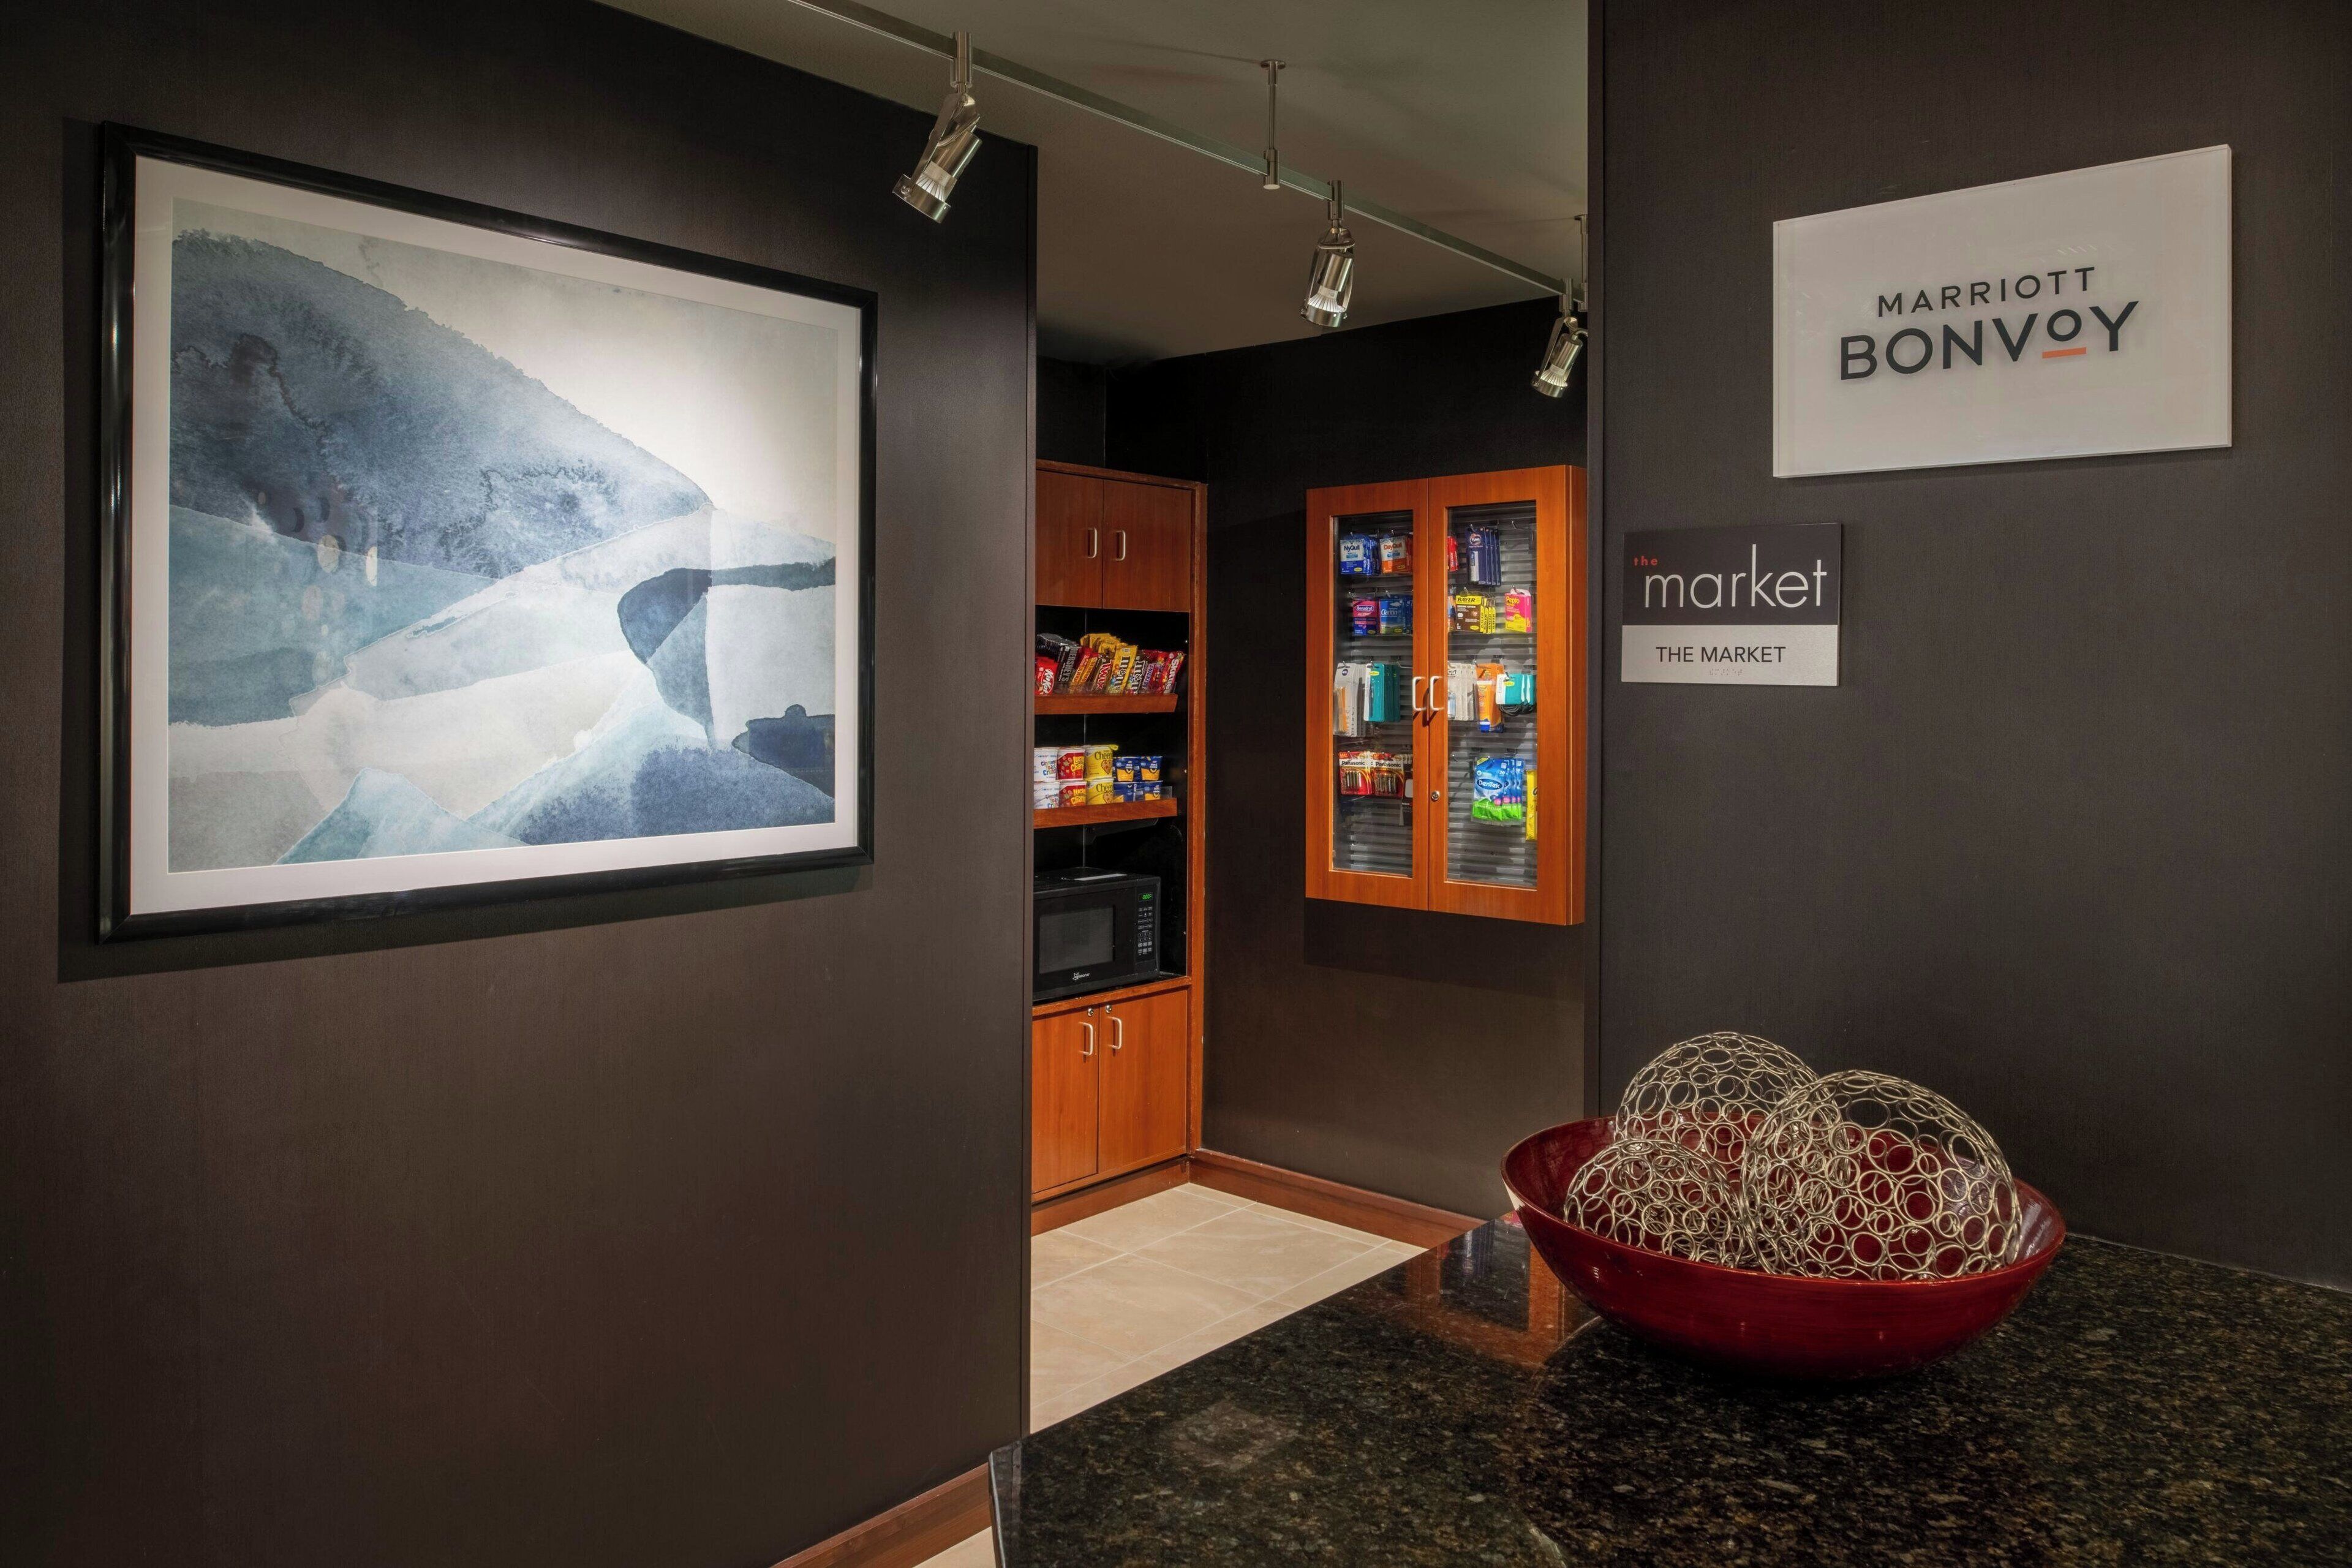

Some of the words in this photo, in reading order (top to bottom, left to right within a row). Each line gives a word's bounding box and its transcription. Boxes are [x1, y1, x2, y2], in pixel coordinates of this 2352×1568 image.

[1878, 266, 2095, 317] MARRIOTT
[1840, 301, 2139, 380] BONVOY
[1633, 556, 1659, 566] the
[1645, 544, 1827, 609] market
[1656, 647, 1694, 663] THE
[1701, 647, 1786, 663] MARKET
[1478, 780, 1500, 789] DenTek
